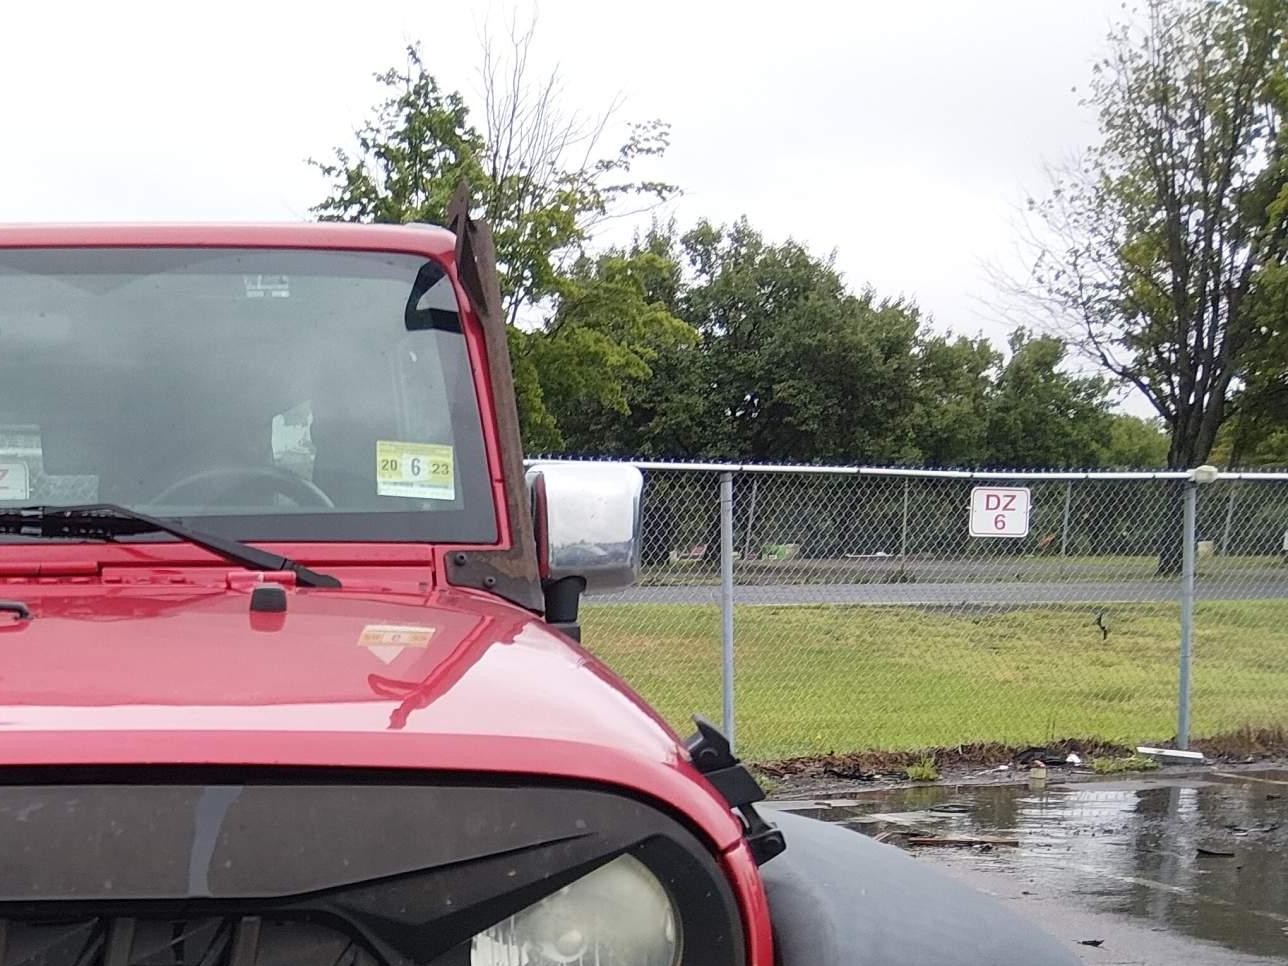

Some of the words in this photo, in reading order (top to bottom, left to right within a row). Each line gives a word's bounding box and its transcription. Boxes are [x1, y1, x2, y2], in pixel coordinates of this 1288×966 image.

[381, 458, 398, 472] 20
[410, 457, 422, 477] 6
[431, 462, 450, 476] 23
[985, 494, 1017, 512] DZ
[993, 513, 1007, 530] 6
